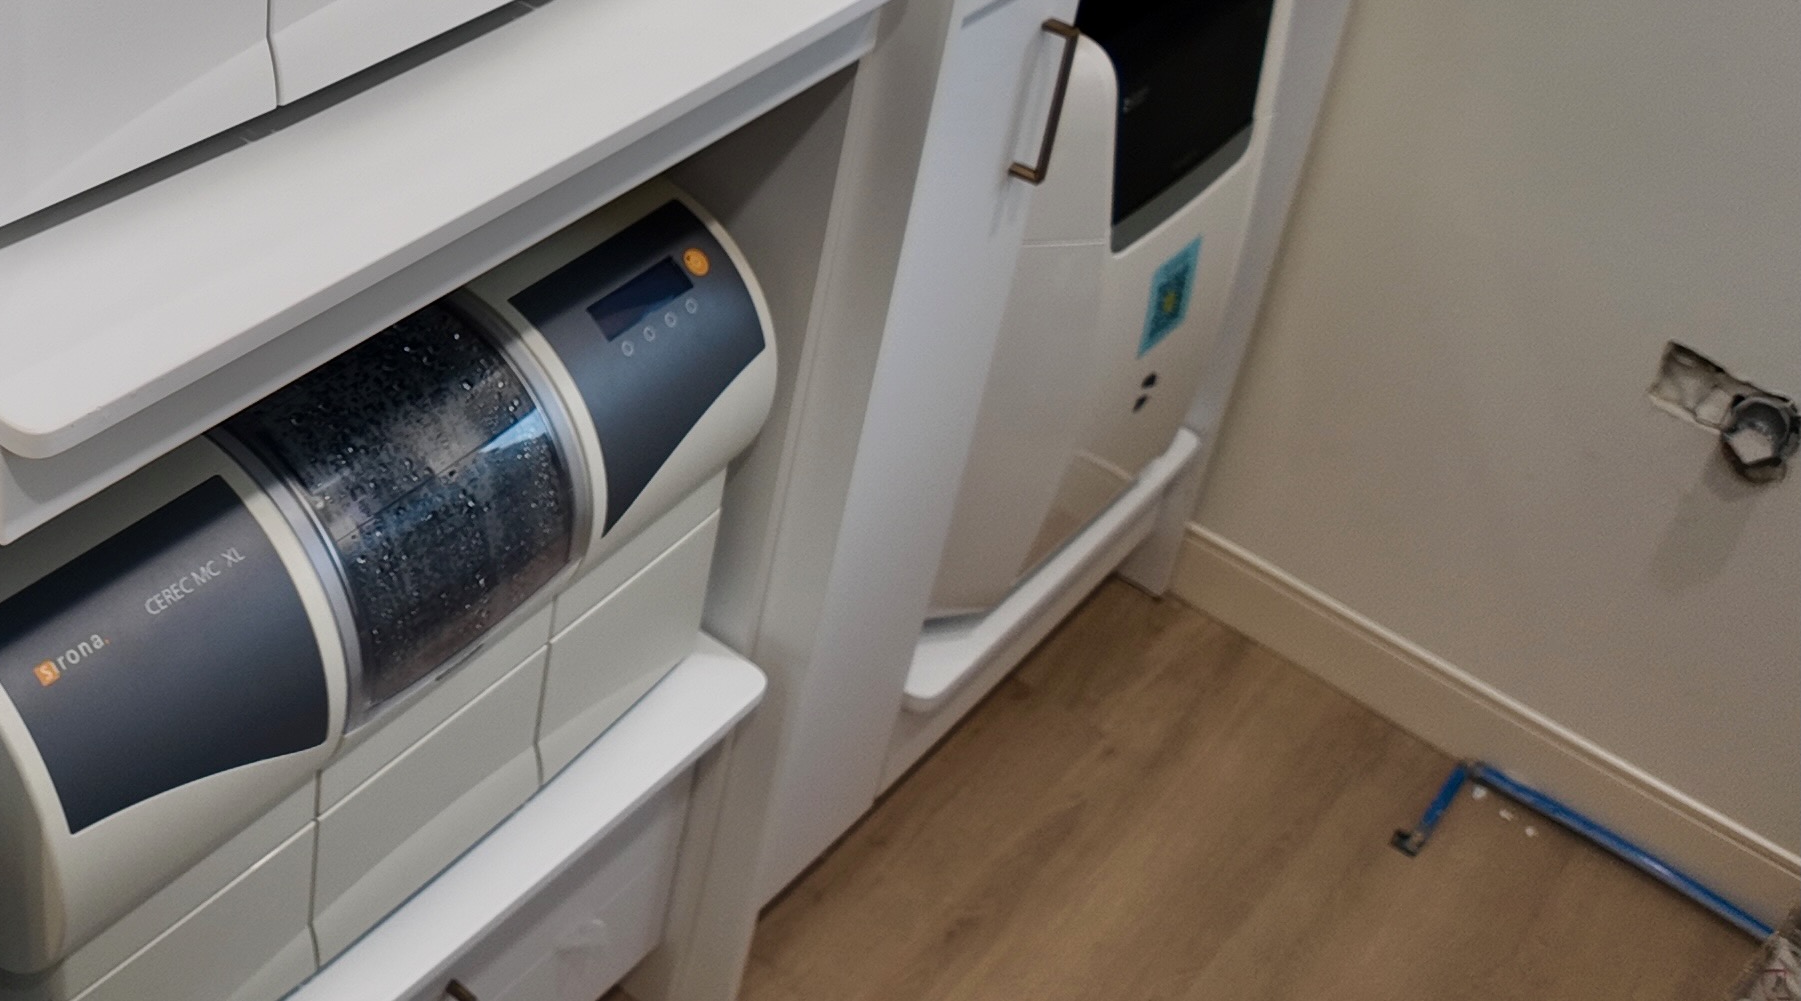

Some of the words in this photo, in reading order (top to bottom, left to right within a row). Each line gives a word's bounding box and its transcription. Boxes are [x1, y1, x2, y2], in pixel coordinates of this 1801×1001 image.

[144, 576, 195, 616] CEREC
[190, 560, 222, 587] MC
[220, 547, 247, 568] XL
